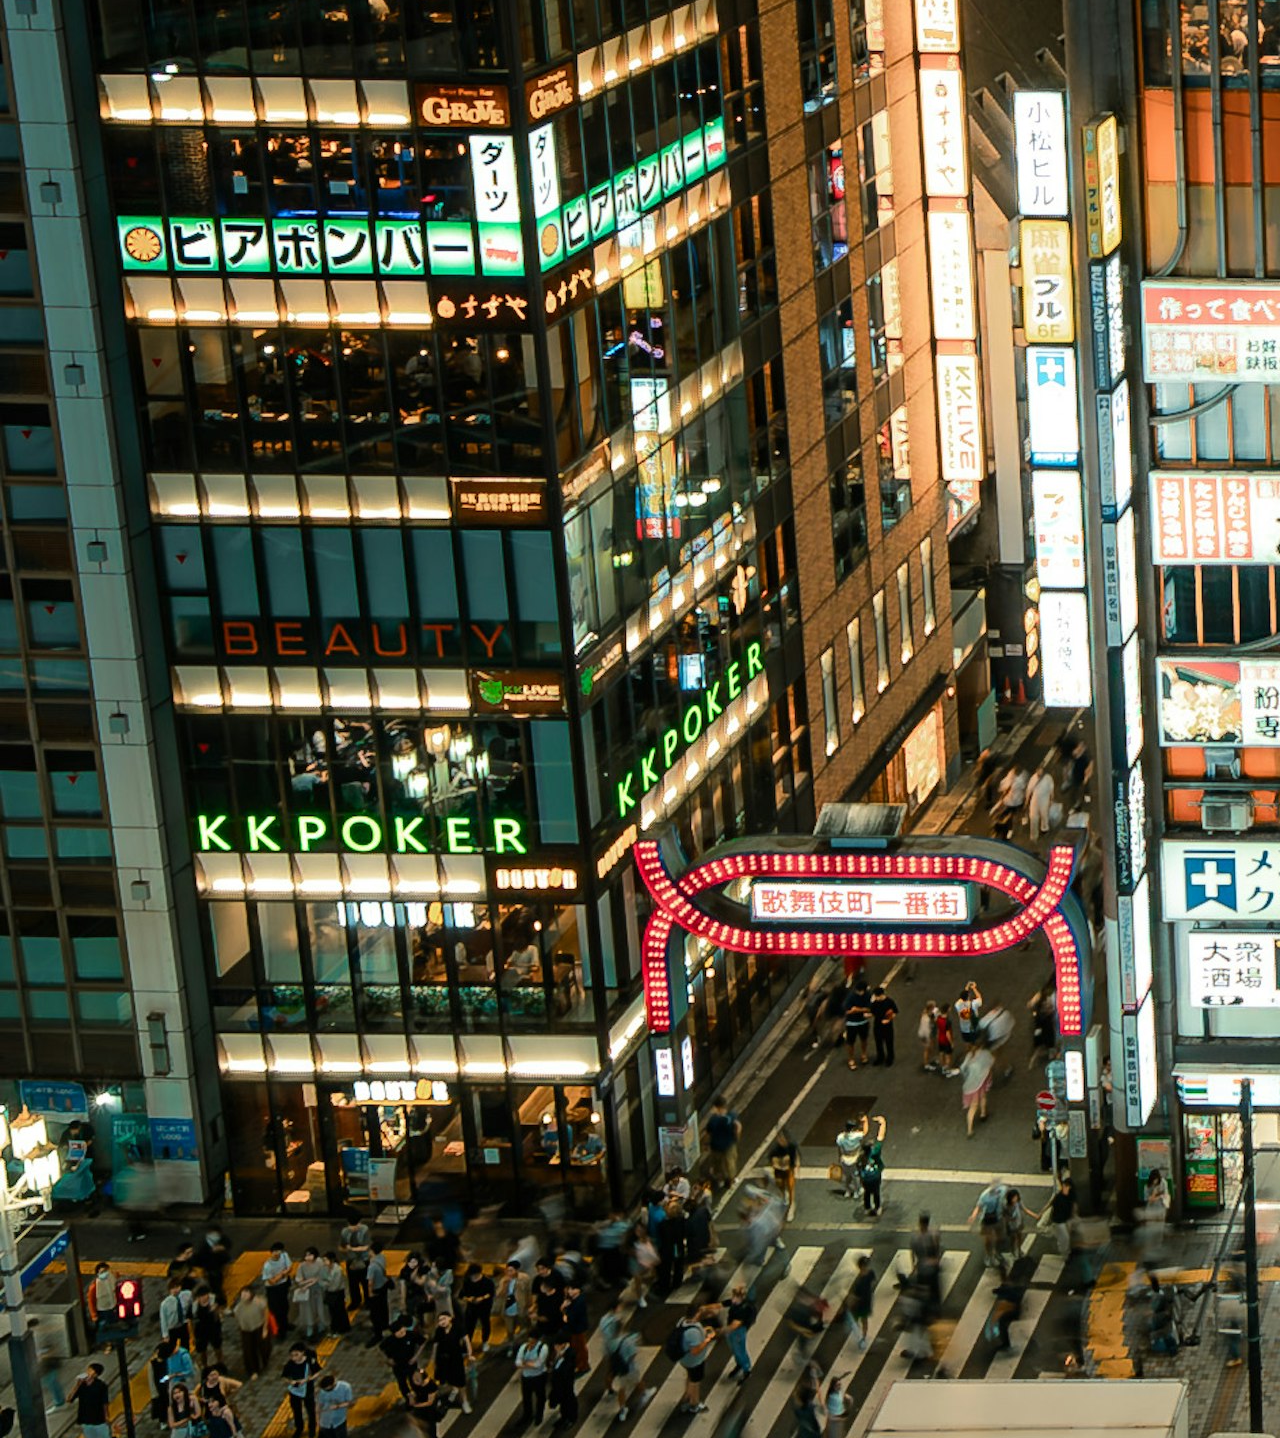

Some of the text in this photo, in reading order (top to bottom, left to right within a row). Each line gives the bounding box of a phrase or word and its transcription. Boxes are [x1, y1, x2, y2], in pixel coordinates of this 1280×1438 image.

[480, 141, 509, 212] ダーツ
[535, 130, 552, 206] ダーツ
[565, 143, 701, 248] ビアポンバー
[170, 223, 469, 272] ビアポンバー
[1036, 322, 1061, 338] 6F
[224, 621, 505, 658] BEAUTY
[616, 641, 766, 818] KKPOKER
[198, 814, 527, 854] KKPOKER
[760, 889, 960, 917] 歌舞伎町一番街
[1201, 941, 1263, 963] 大衆
[1202, 966, 1263, 989] 酒場
